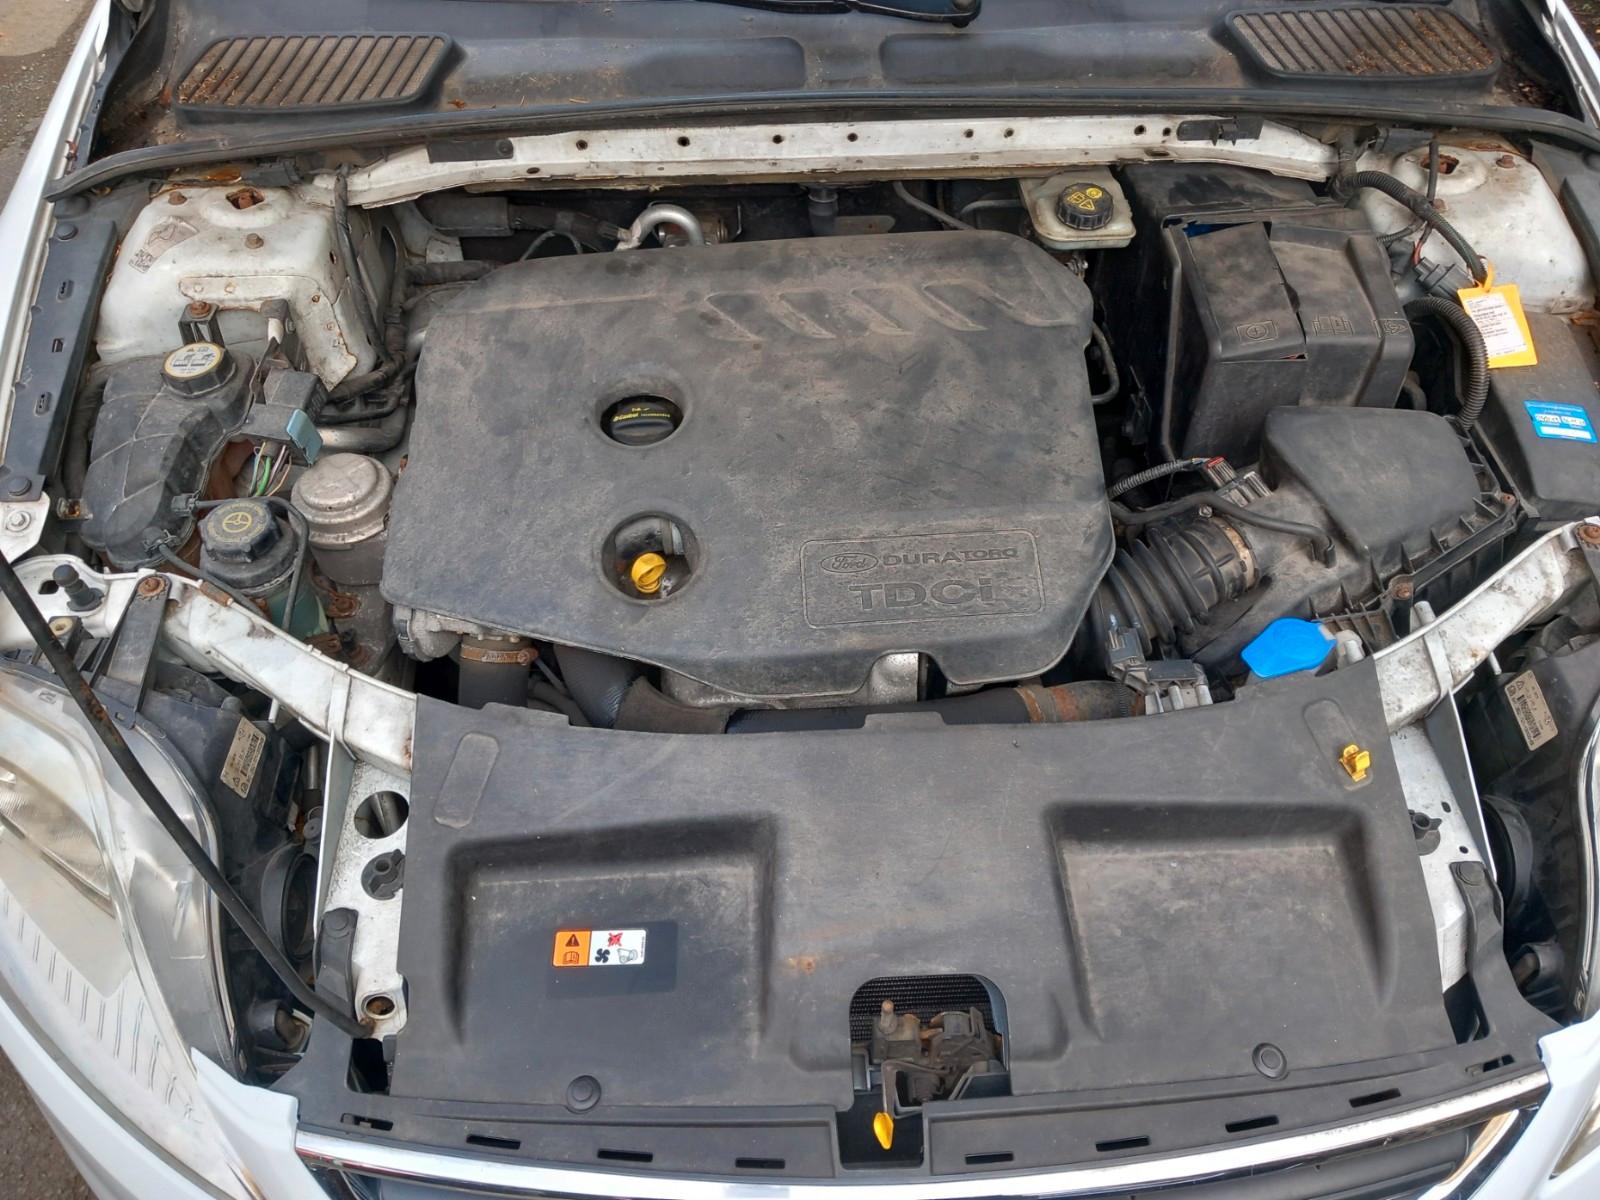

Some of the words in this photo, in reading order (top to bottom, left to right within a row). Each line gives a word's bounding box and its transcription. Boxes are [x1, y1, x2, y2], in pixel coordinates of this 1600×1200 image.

[831, 554, 867, 569] Ford
[882, 547, 1019, 566] DURATORQ
[848, 577, 995, 611] TDCi
